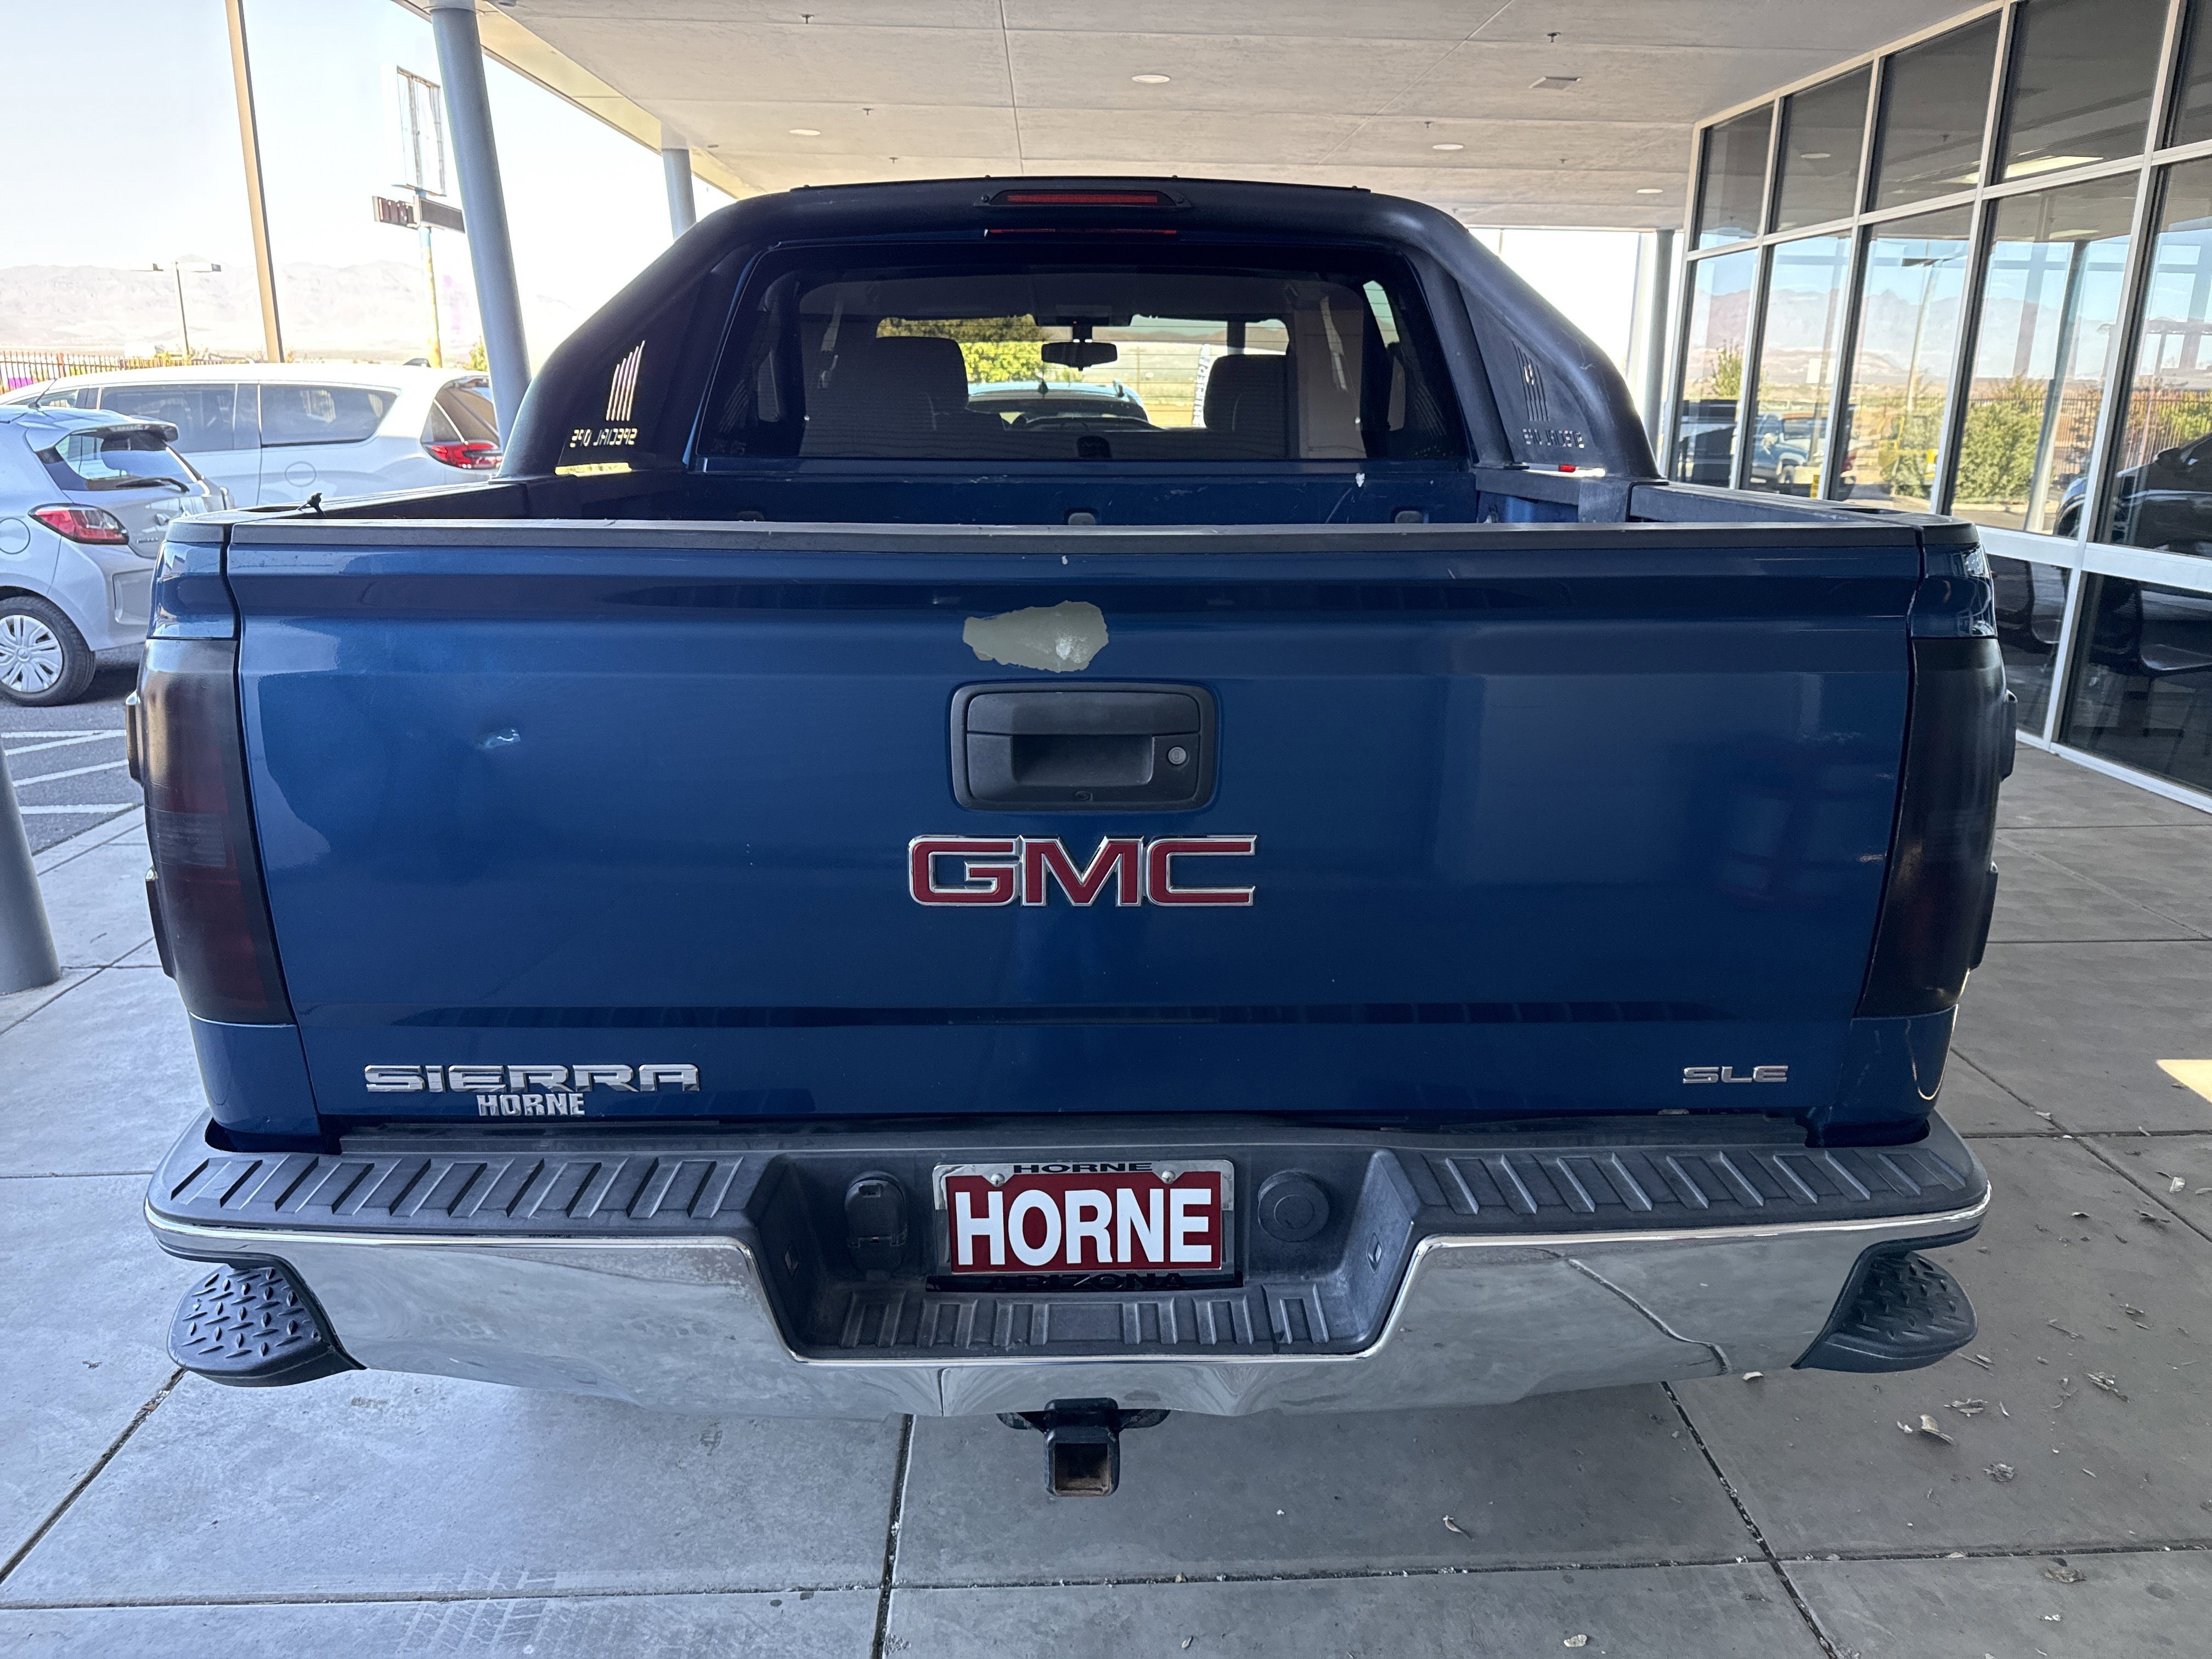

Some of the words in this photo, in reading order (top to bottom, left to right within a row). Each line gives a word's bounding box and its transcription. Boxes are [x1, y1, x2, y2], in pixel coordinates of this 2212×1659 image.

[909, 834, 1257, 906] GMC
[364, 1064, 700, 1093] SIERRA
[1683, 1065, 1788, 1084] SLE
[476, 1093, 586, 1116] HORNE
[1013, 1162, 1153, 1173] HORNE
[955, 1188, 1212, 1266] HORNE
[989, 1273, 1192, 1290] ARIZONA
